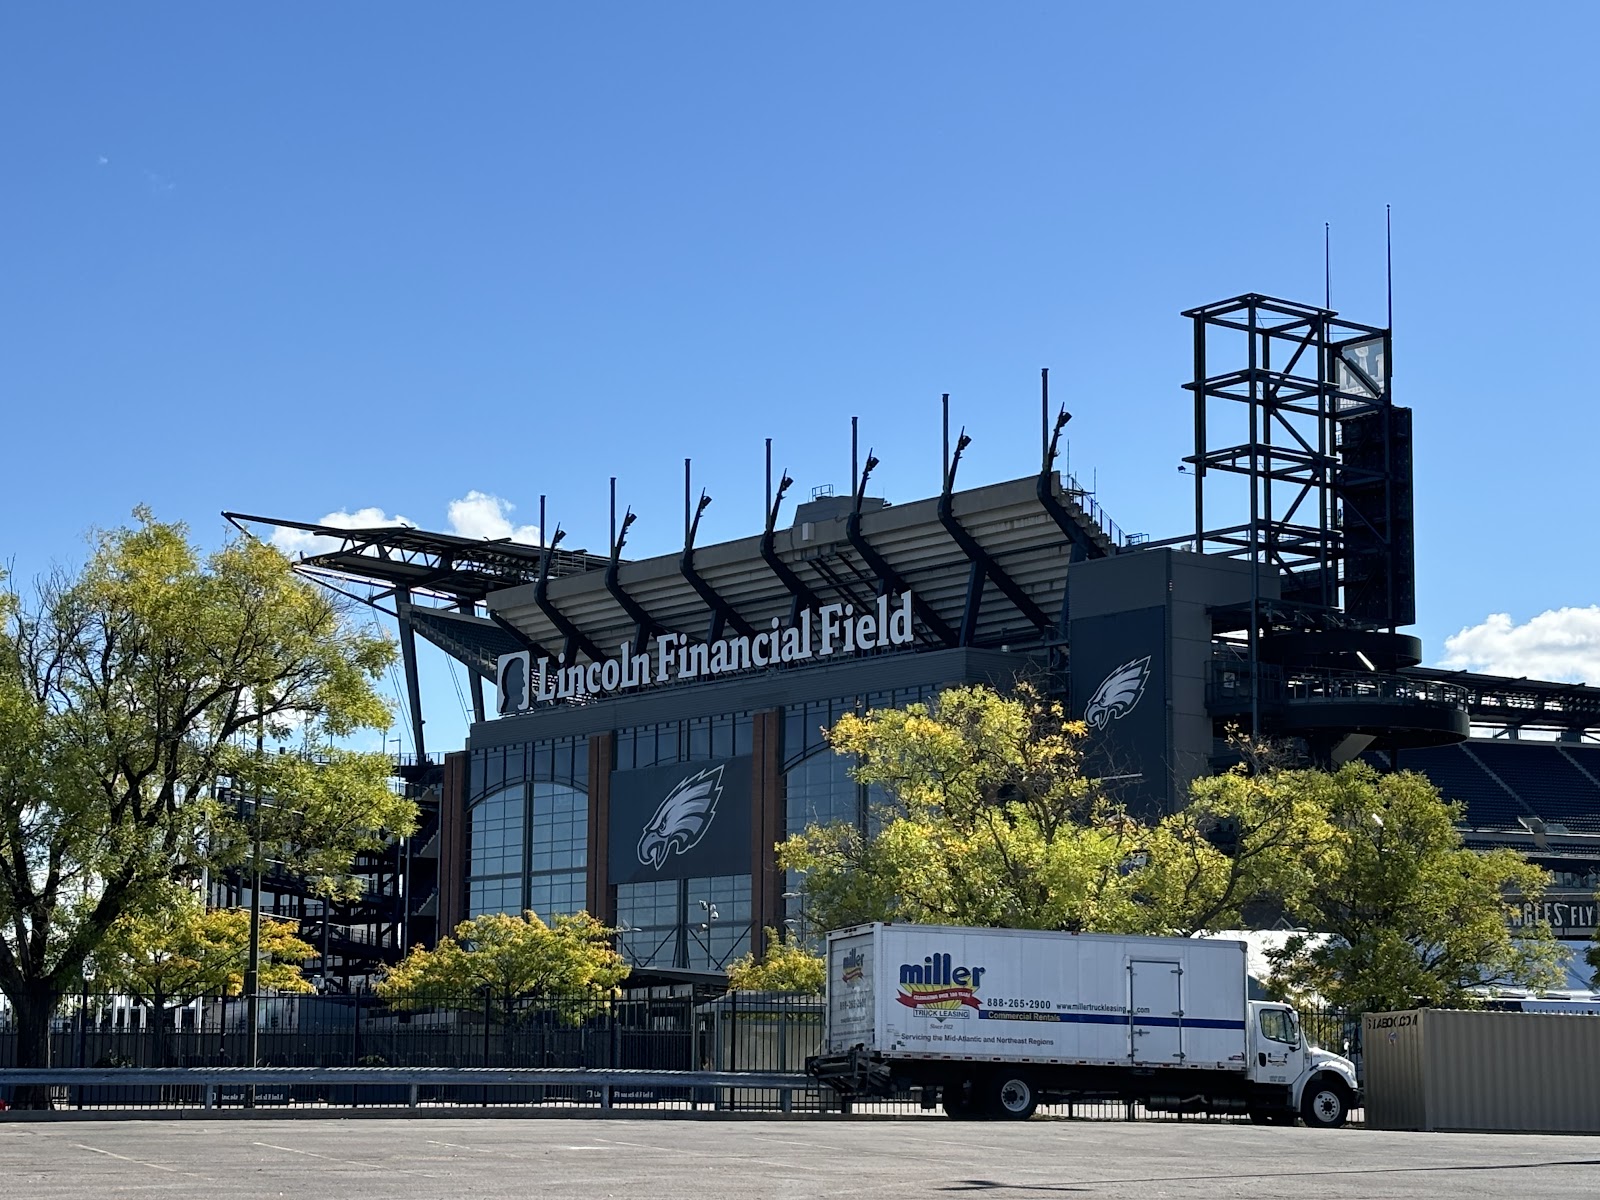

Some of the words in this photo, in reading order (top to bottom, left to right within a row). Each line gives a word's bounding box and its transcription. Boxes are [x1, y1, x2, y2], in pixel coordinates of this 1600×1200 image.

[537, 641, 651, 701] Lincoln
[656, 608, 812, 682] Financial
[818, 590, 915, 655] Field
[1570, 906, 1593, 926] FLY
[900, 953, 987, 987] miller
[939, 1010, 969, 1018] LEASING
[1056, 1003, 1150, 1014] www.millertruckleasingcom
[988, 1012, 1032, 1021] Commercial
[1033, 1014, 1061, 1022] Rentals
[901, 1033, 931, 1042] Servicing
[1028, 1038, 1054, 1046] Regions
